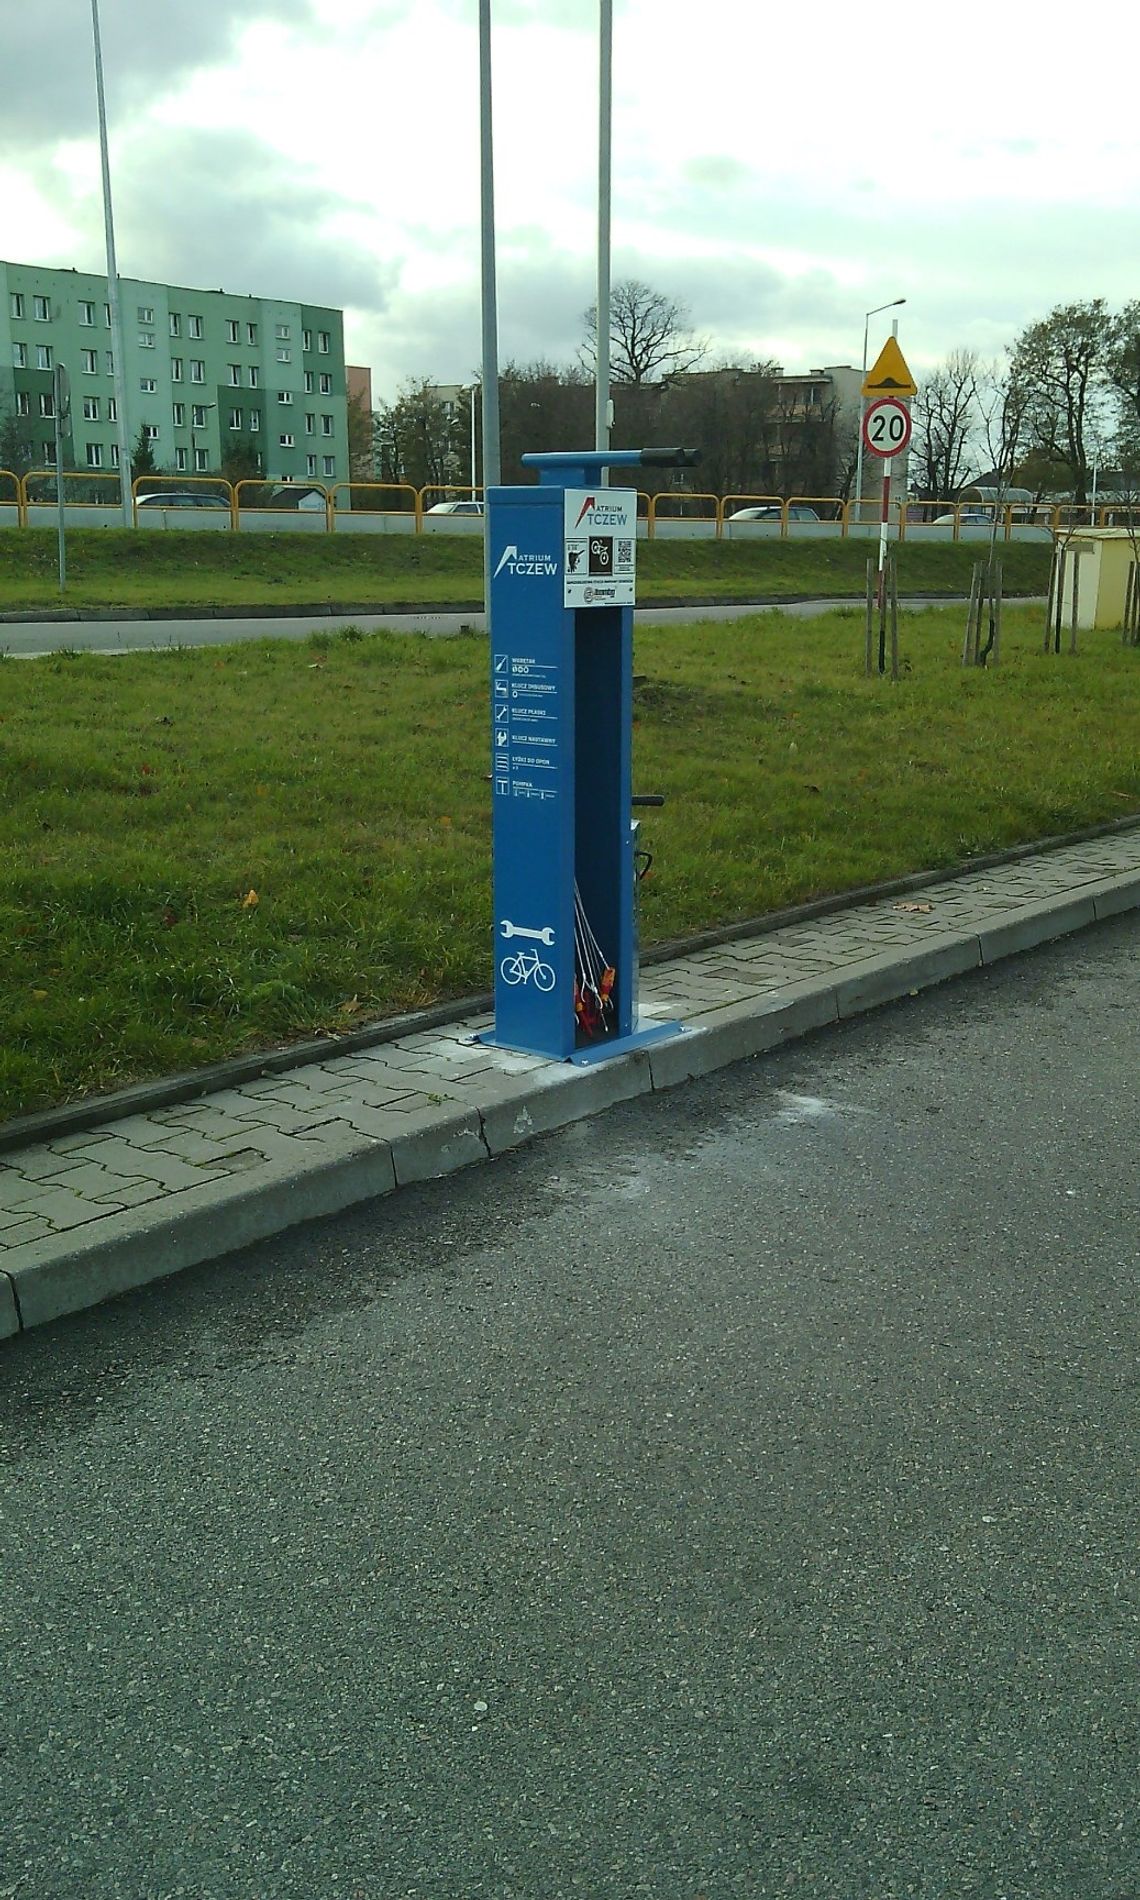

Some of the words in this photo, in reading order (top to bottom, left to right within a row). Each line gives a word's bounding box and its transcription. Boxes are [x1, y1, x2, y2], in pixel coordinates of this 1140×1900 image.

[872, 415, 905, 441] 20
[587, 513, 628, 526] TCZEW
[518, 554, 551, 562] ATRIUM
[507, 562, 558, 575] TCZEW
